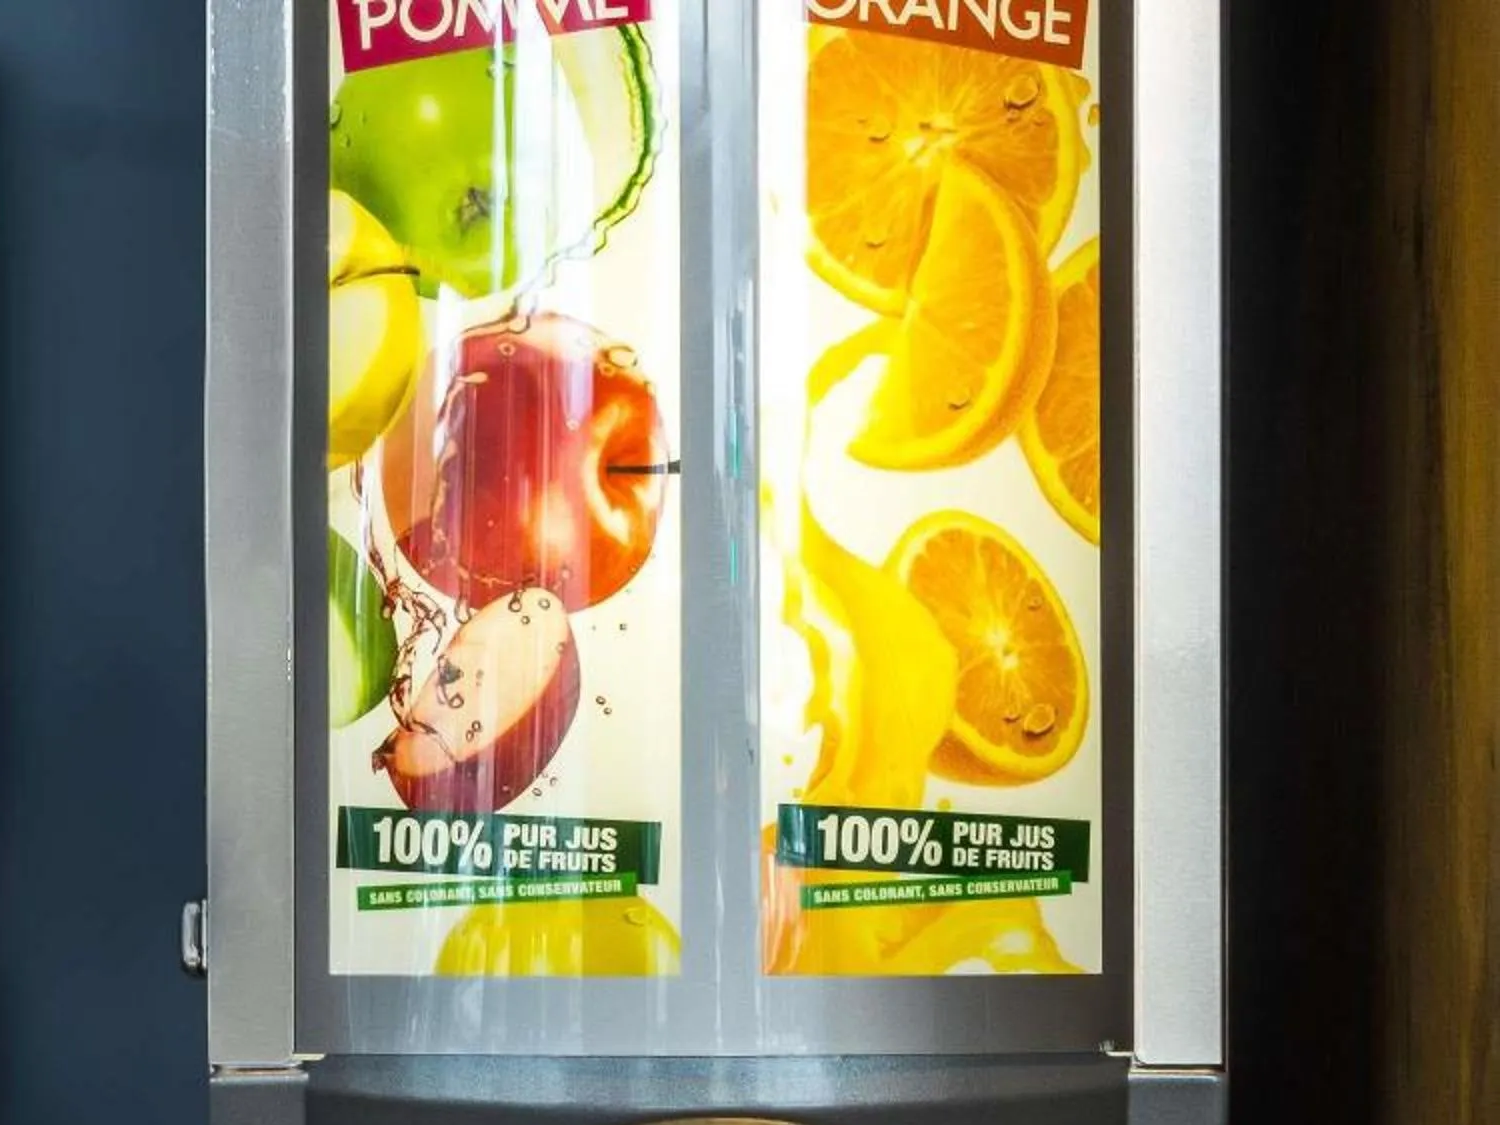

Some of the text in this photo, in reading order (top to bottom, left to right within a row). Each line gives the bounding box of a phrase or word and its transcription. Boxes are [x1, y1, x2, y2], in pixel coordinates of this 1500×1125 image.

[373, 816, 493, 870] 100%
[503, 823, 618, 852] PUR JUS
[817, 814, 943, 868] 100%
[952, 821, 1056, 850] PUR JUS
[503, 850, 618, 873] DE FRUITS
[952, 847, 1055, 871] DE FRUITS
[368, 890, 403, 906] SANS
[477, 883, 515, 900] SANS
[518, 878, 623, 898] CONSERVATEUR
[812, 877, 1060, 905] SANS COLORANT, SANS CONSERVATEUR
